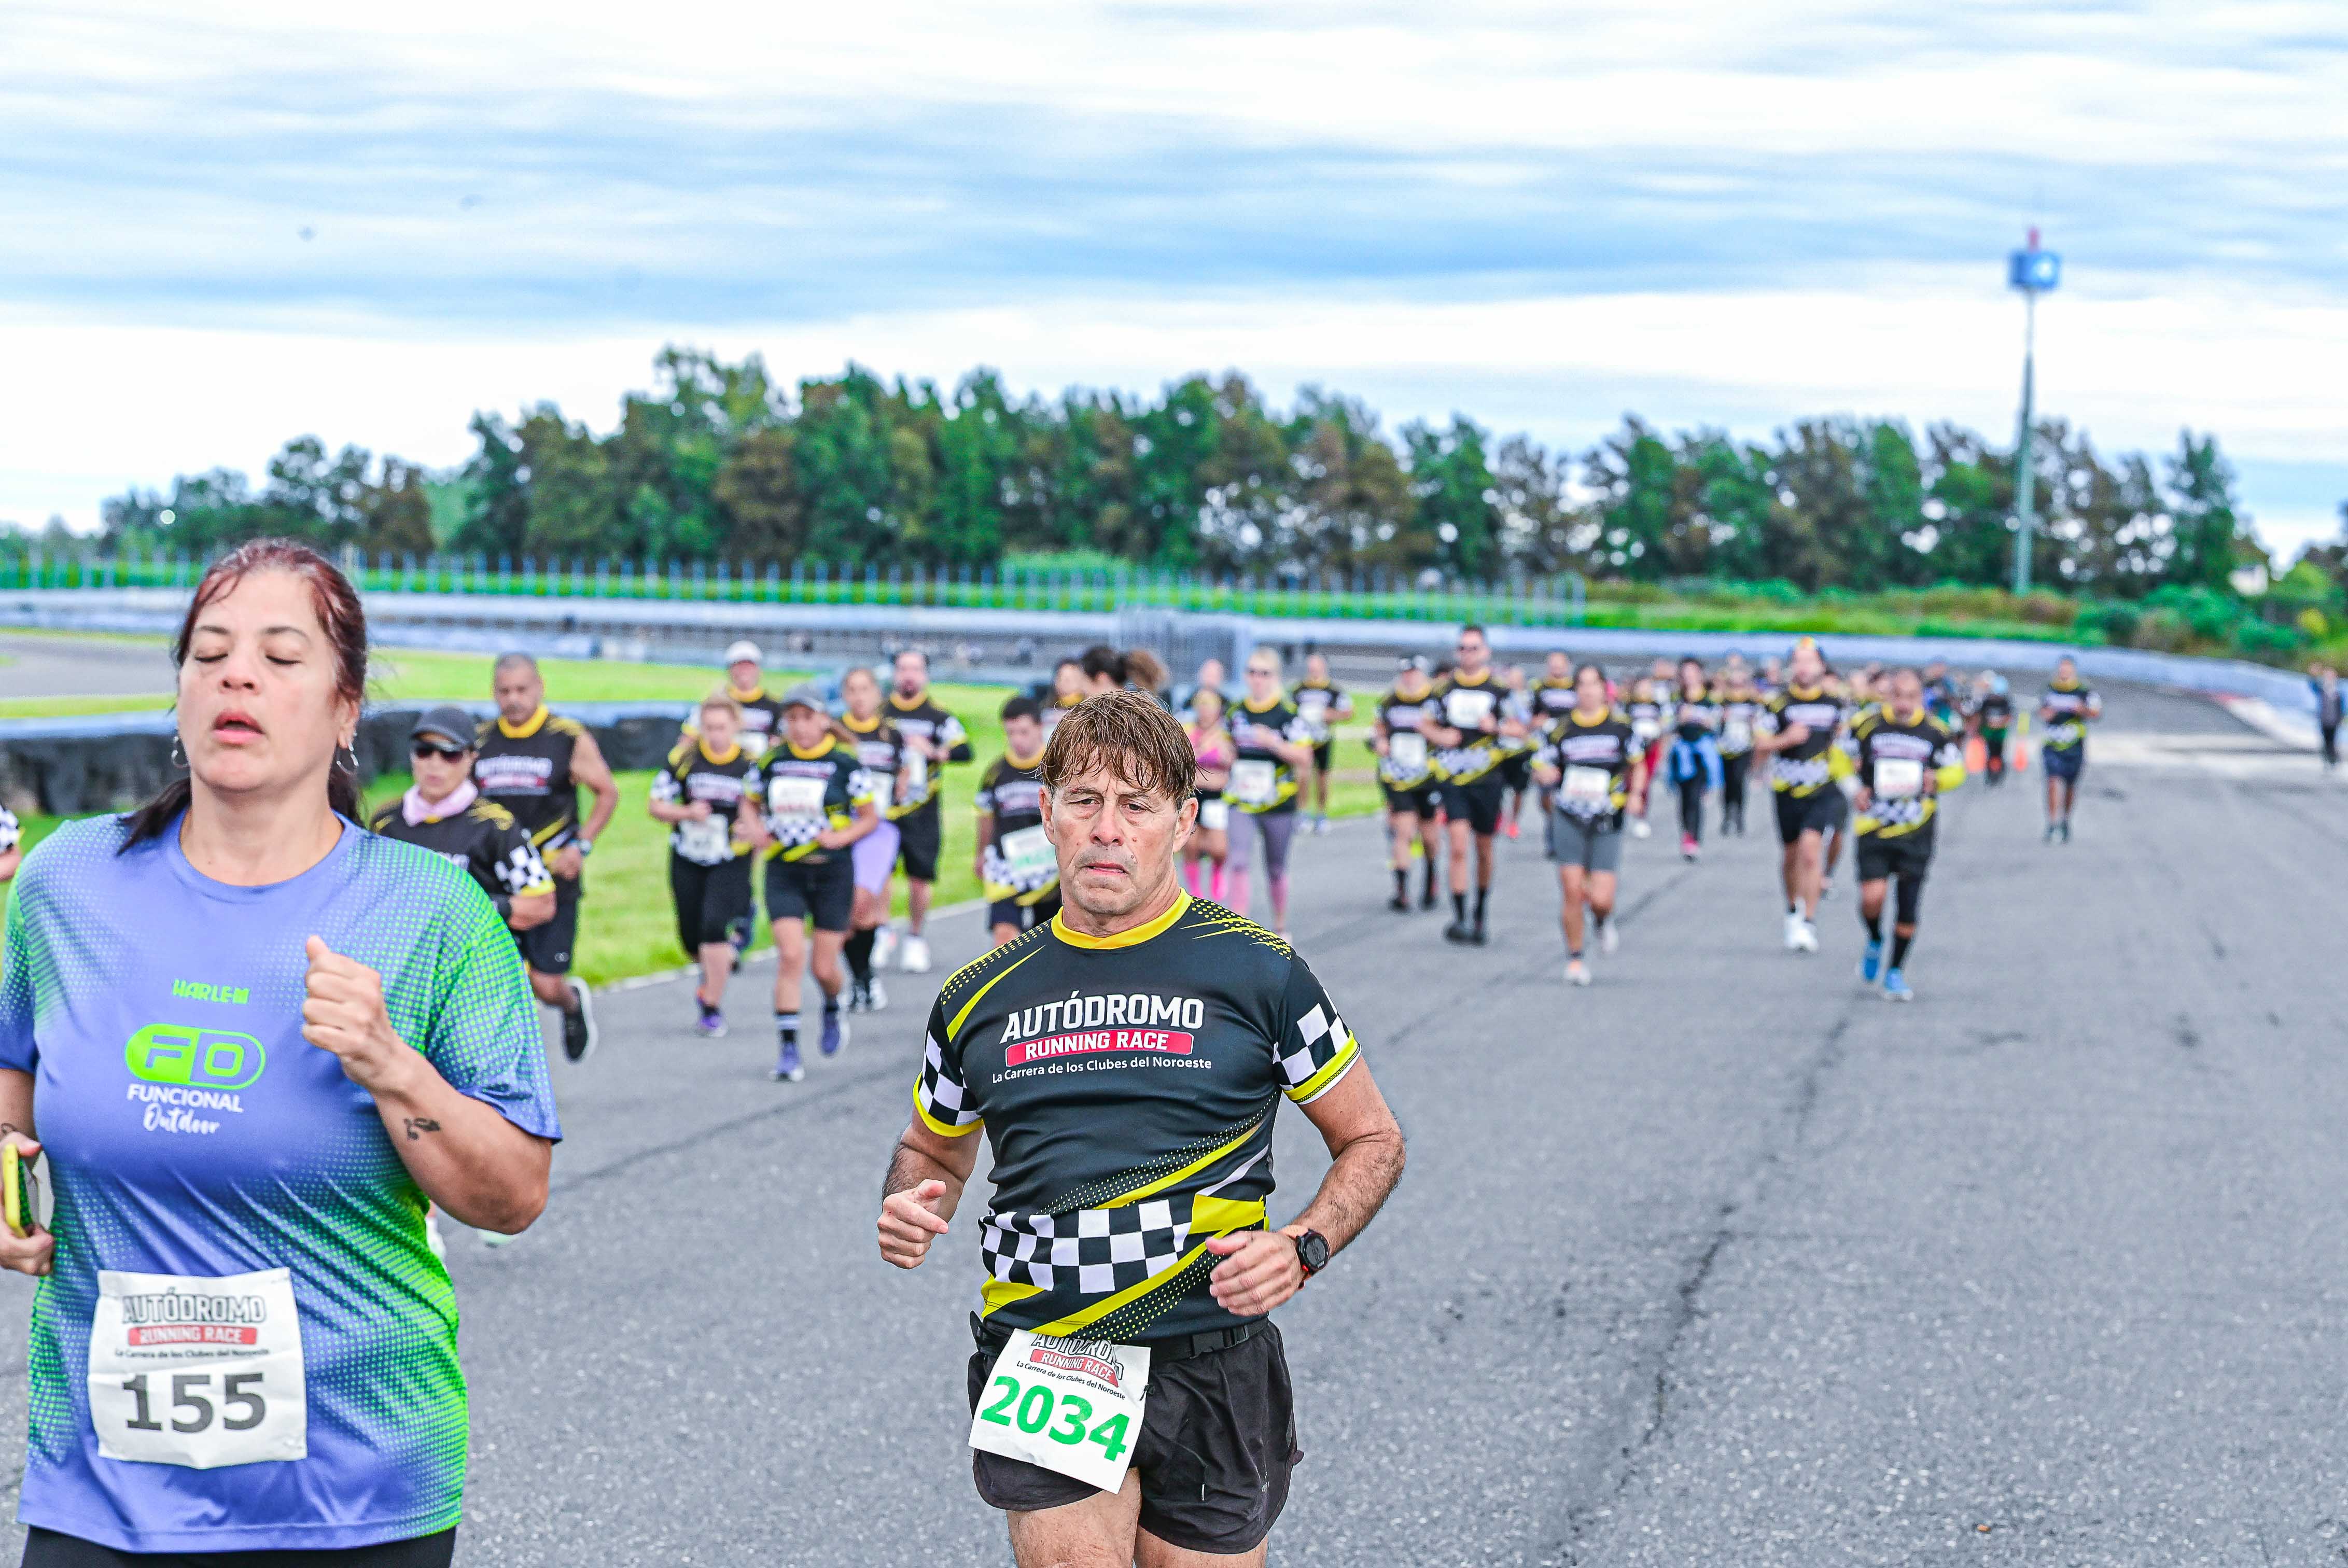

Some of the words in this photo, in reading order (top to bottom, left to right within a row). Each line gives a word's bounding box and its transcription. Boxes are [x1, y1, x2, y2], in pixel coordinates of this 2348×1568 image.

[173, 979, 250, 1004] HARLEM
[999, 990, 1204, 1044] AUTÓDROMO
[1025, 1032, 1110, 1060] RUNNING
[1115, 1031, 1169, 1050] RACE
[992, 1072, 1002, 1084] La
[1004, 1067, 1045, 1081] Carrera
[1047, 1062, 1063, 1074] de
[1066, 1061, 1084, 1072] los
[1086, 1058, 1127, 1071] Clubes
[1130, 1057, 1150, 1068] del
[1153, 1057, 1212, 1069] Noroeste
[127, 1083, 244, 1113] FUNCIONAL
[143, 1103, 220, 1135] Outdoor
[122, 1286, 267, 1324] AUTÓDROMO
[139, 1327, 201, 1344] RUNNING
[204, 1327, 243, 1343] RACE
[1025, 1363, 1046, 1374] Carrera
[1066, 1376, 1085, 1384] Clubes
[1086, 1380, 1097, 1388] del
[1098, 1384, 1125, 1400] Noroeste
[1041, 1352, 1084, 1369] RUNNING
[1084, 1360, 1113, 1380] RACE
[122, 1373, 265, 1433] 155
[981, 1376, 1130, 1462] 2034
